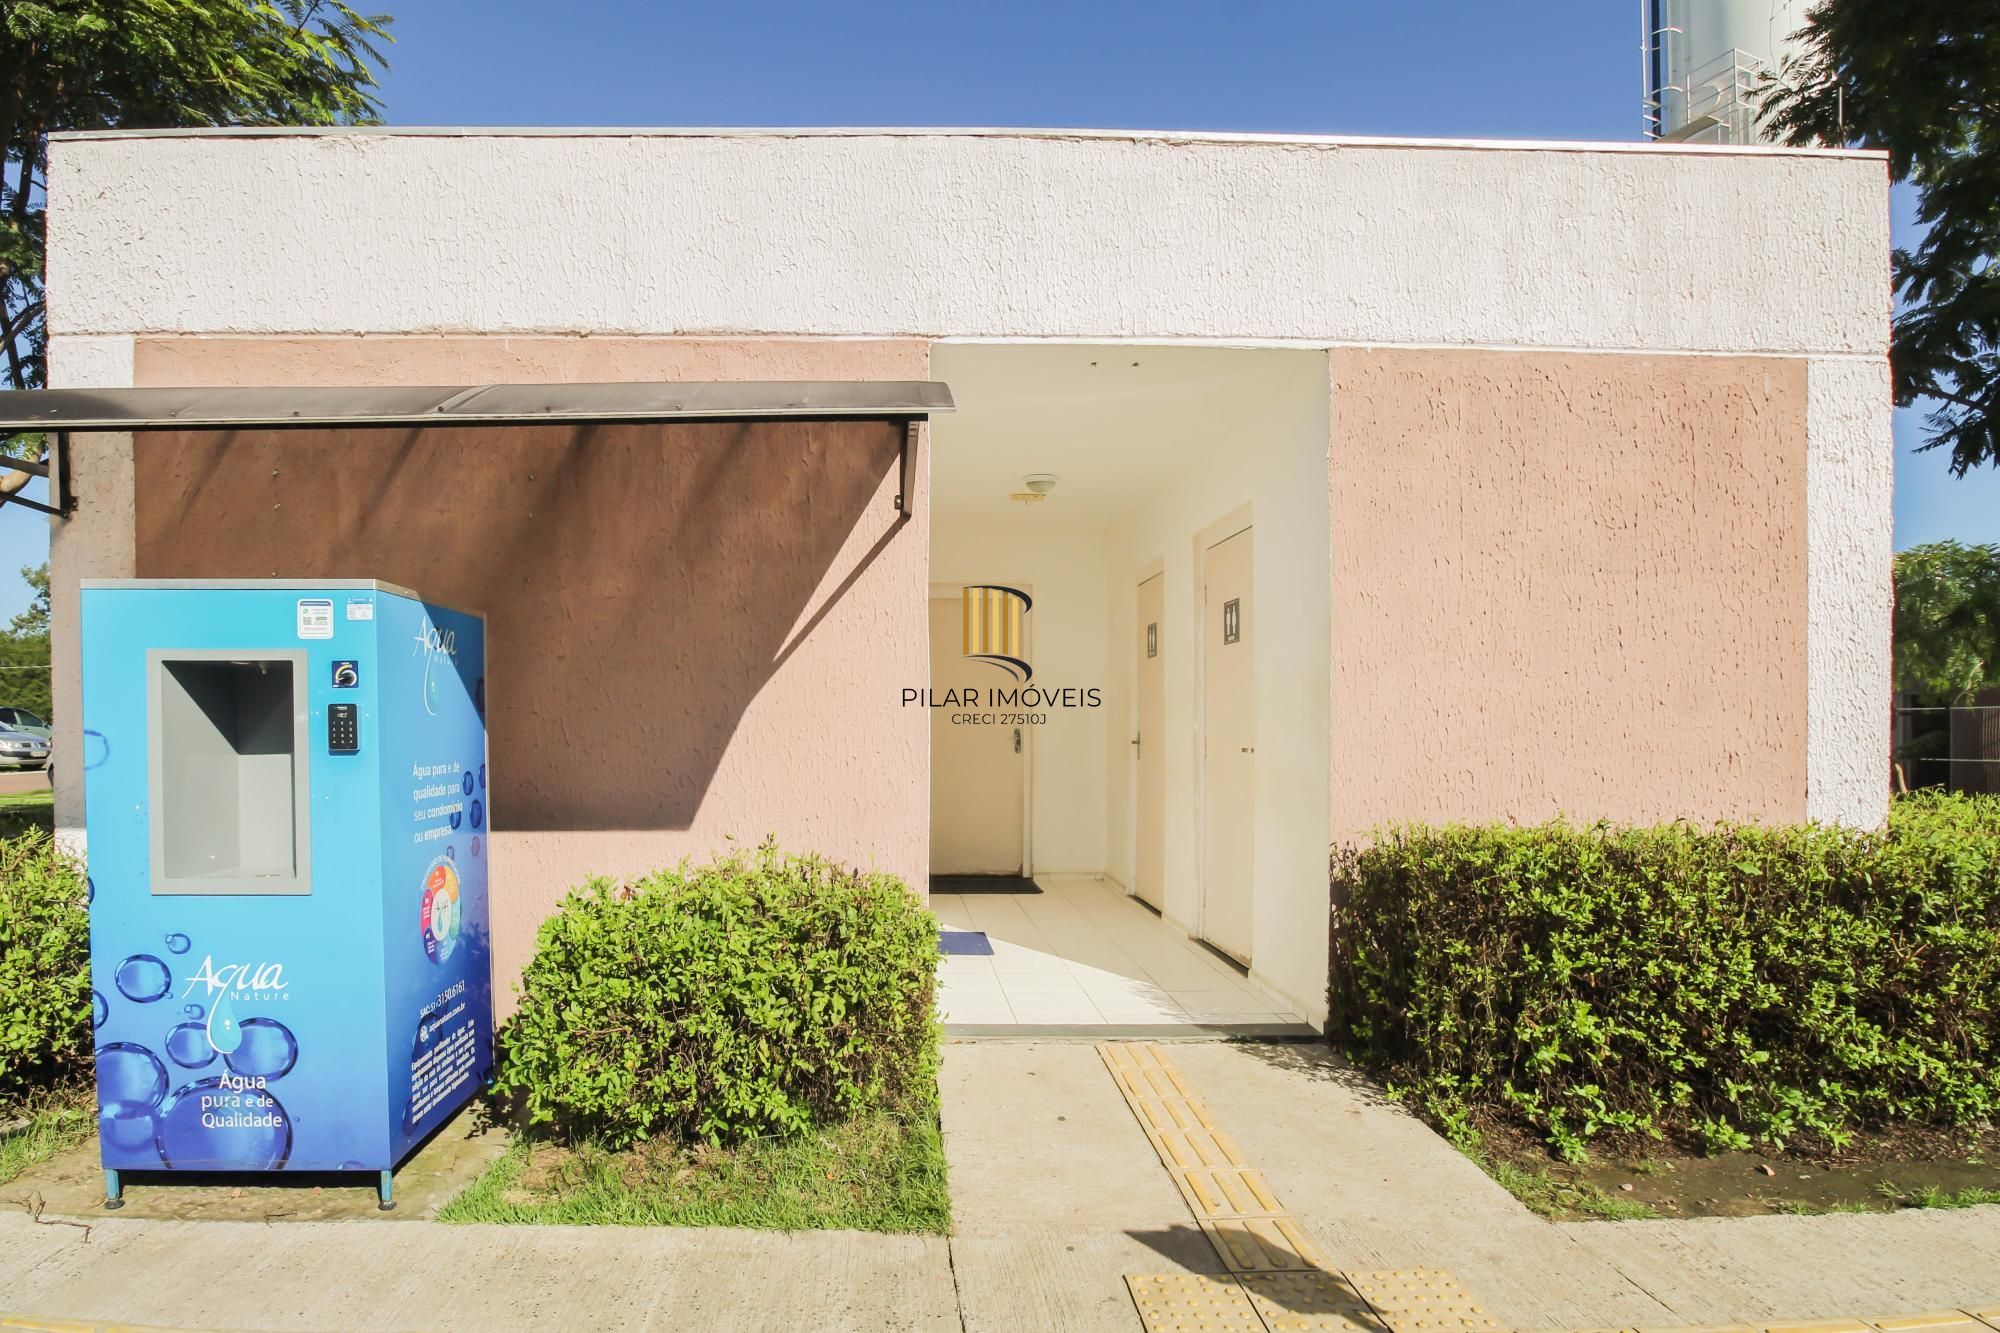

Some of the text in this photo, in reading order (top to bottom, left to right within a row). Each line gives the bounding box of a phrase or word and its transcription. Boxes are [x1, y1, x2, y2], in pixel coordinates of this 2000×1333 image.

[413, 760, 431, 780] Água
[432, 764, 447, 779] pura
[453, 760, 460, 774] de
[413, 783, 461, 803] qualidade para
[414, 809, 426, 822] seu
[414, 830, 424, 843] ou
[230, 991, 289, 1001] Nature
[218, 1069, 267, 1093] Água
[201, 1094, 274, 1112] pura e de
[201, 1112, 283, 1129] Qualidade
